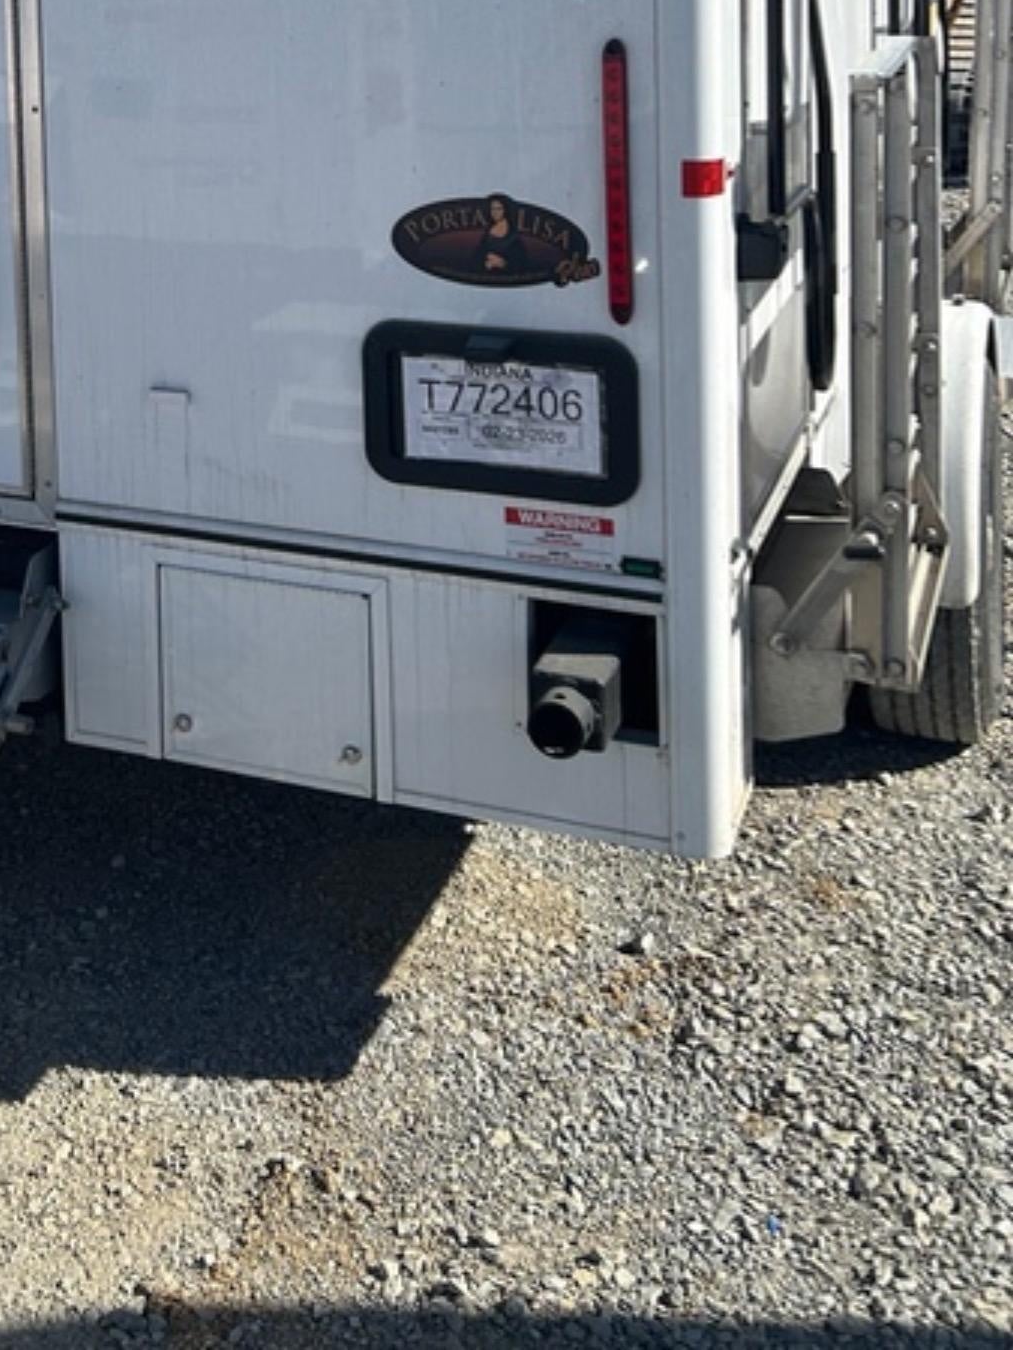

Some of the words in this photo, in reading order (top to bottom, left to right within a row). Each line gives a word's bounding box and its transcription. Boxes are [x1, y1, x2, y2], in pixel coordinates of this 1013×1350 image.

[404, 207, 488, 242] PORTA
[517, 209, 570, 249] LISA
[466, 362, 533, 382] INDIANA
[418, 378, 583, 422] T772406
[519, 509, 601, 532] WARNING
